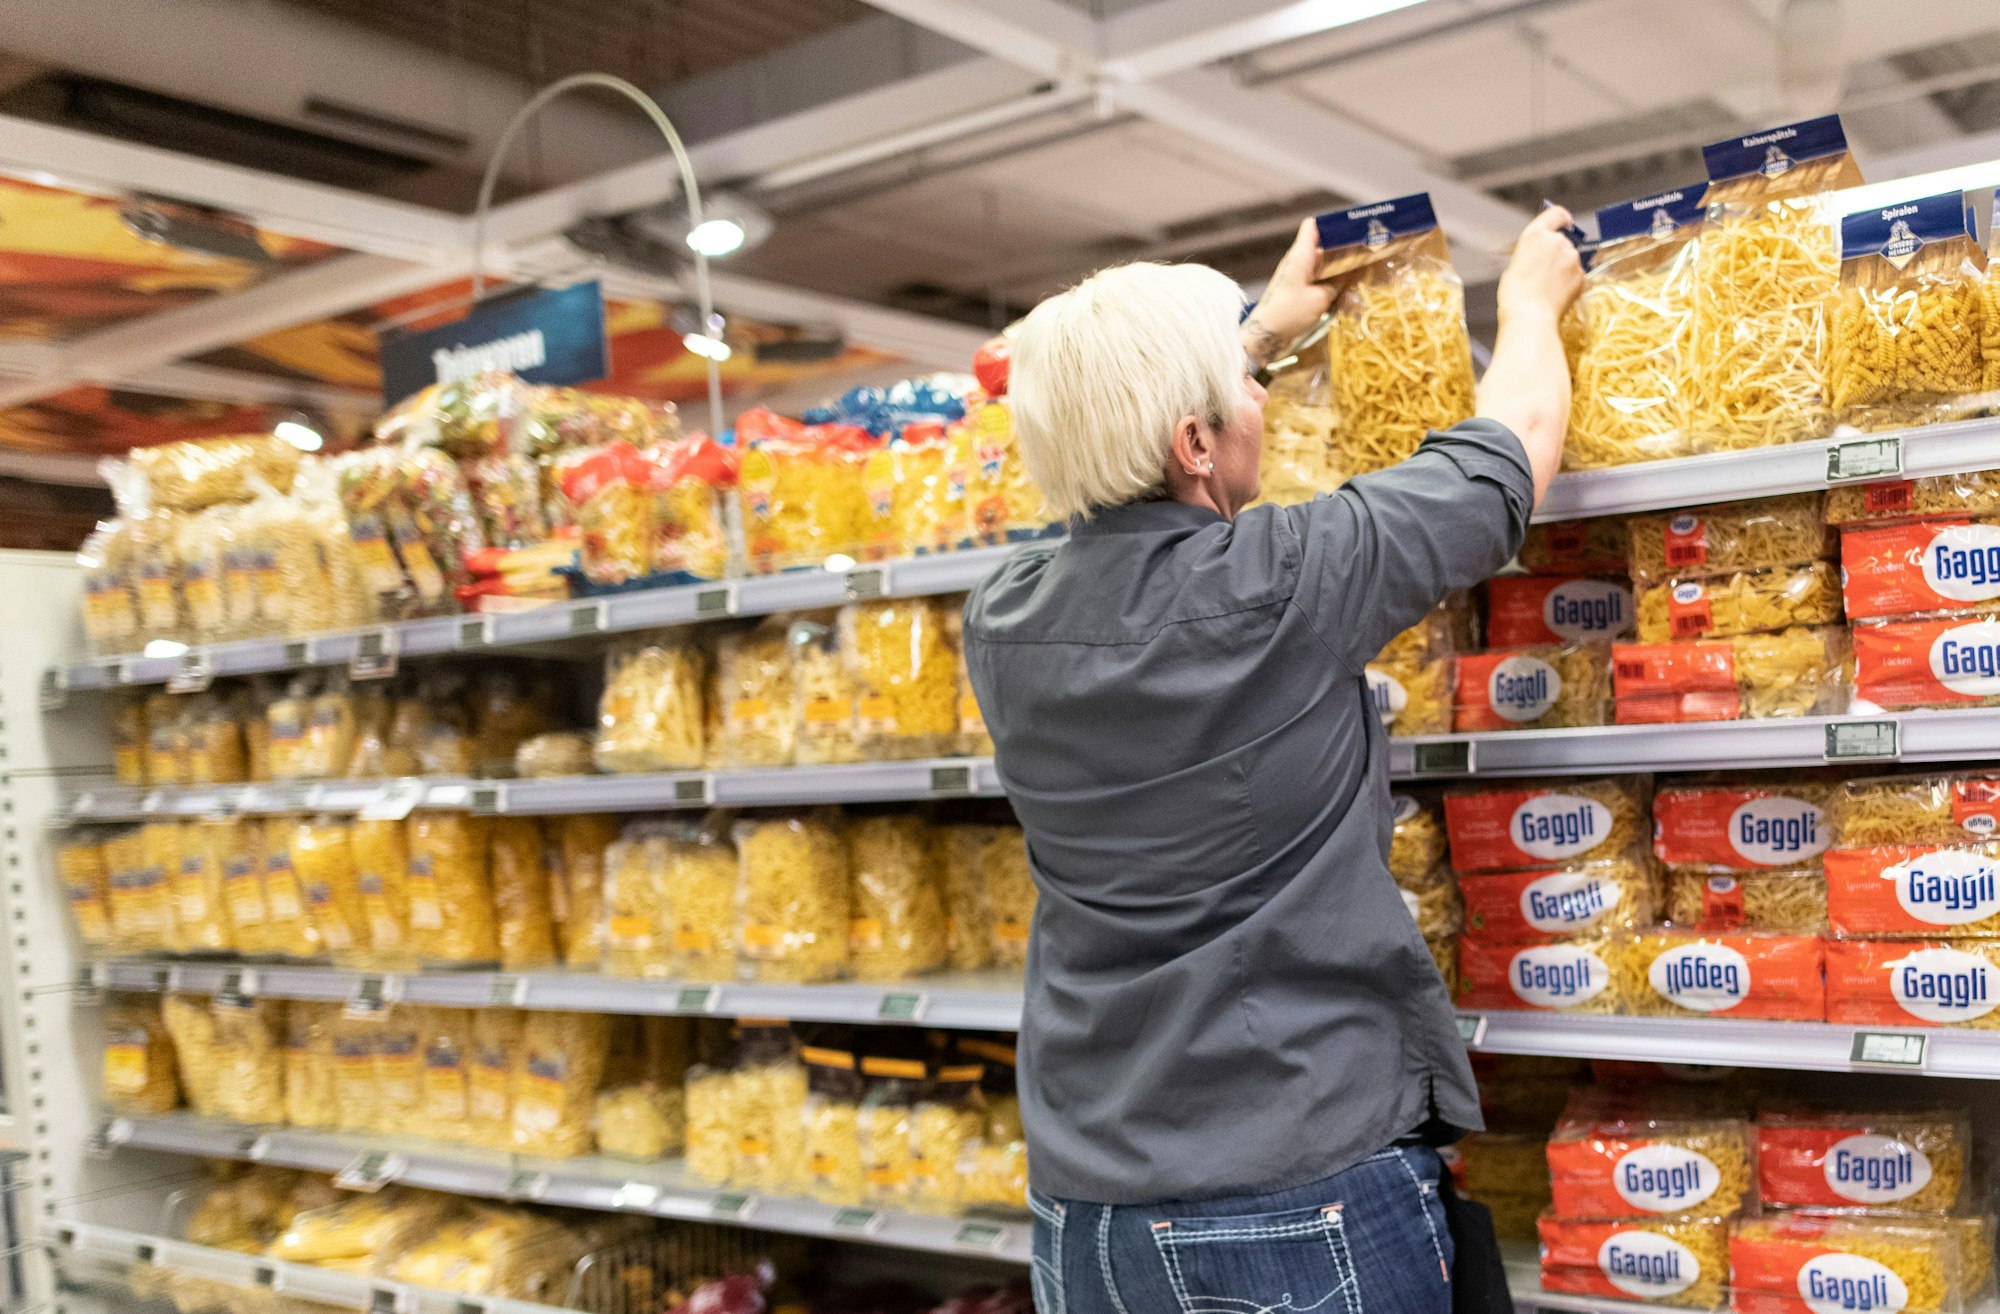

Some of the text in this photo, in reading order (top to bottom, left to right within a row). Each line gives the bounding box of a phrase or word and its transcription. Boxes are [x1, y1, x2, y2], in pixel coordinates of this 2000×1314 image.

[1881, 205, 1918, 221] Spiralen
[1888, 239, 1914, 250] UNSERE
[1888, 246, 1914, 257] HEIMAT
[1552, 592, 1621, 630] Gaggli
[1942, 640, 2000, 678] Gag
[1495, 669, 1547, 708] Gaggli
[1520, 805, 1594, 846] Gaggli
[1740, 812, 1816, 851] Gaggli
[1530, 880, 1603, 922] Gaggli
[1909, 868, 1995, 910] Gaggli
[1519, 957, 1590, 996] Gaggli
[1666, 956, 1740, 996] Gaggli
[1903, 966, 1987, 1008] Gaggli
[1625, 1161, 1700, 1198] Gaggli
[1836, 1150, 1912, 1189] Gaggli
[1608, 1245, 1680, 1284] Gaggli
[1809, 1269, 1887, 1311] Gaggli
